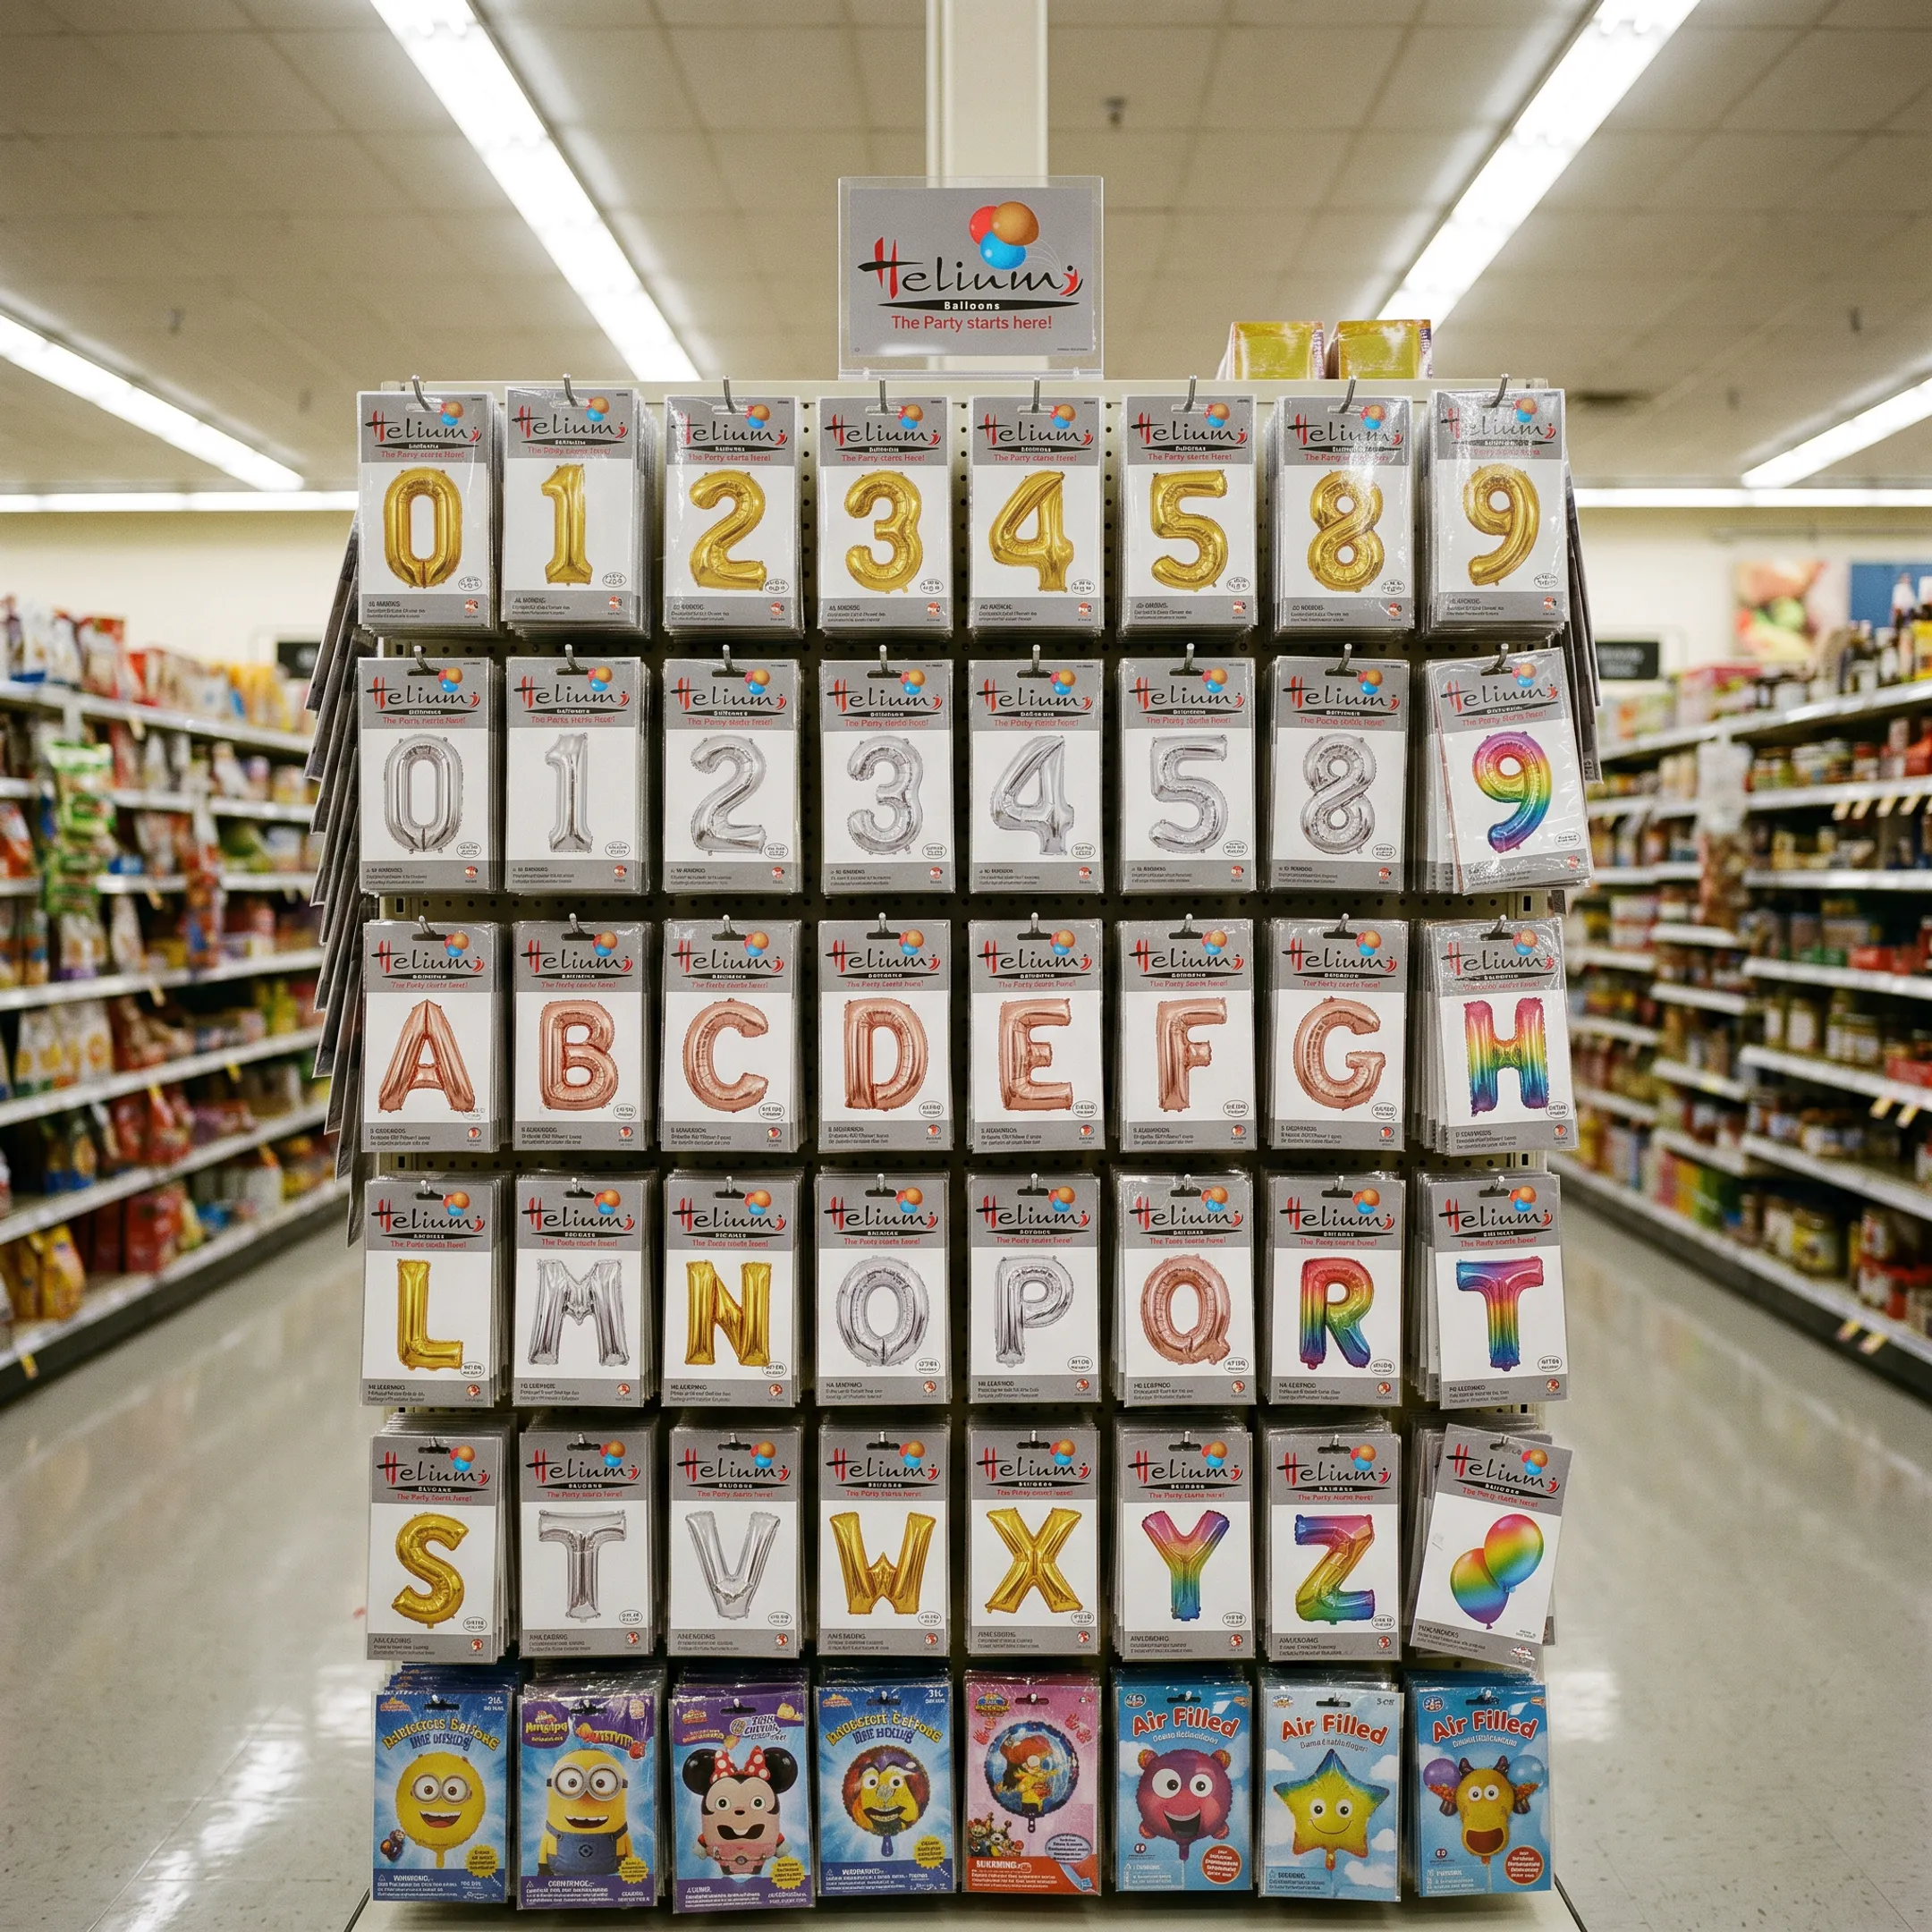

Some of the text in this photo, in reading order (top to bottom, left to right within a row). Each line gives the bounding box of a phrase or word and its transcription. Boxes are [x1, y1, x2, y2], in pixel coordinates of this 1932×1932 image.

[858, 236, 1080, 300] Helium
[944, 301, 1001, 310] Balloons
[891, 315, 1052, 333] The Party starts here!
[365, 411, 481, 443] Helium
[512, 405, 628, 437] Helium
[672, 410, 788, 445] Helium
[825, 414, 941, 445] Helium
[977, 414, 1094, 445] Helium
[1131, 411, 1248, 445] Helium
[1287, 414, 1402, 445] Helium
[384, 466, 462, 589] 0
[541, 463, 593, 585] 1
[689, 470, 766, 590] 2
[844, 470, 921, 593] 3
[989, 470, 1073, 592] 4
[1150, 470, 1228, 592] 5
[1308, 470, 1385, 593] 8
[1462, 463, 1539, 587] 9
[366, 676, 480, 709] Helium
[513, 675, 630, 708] Helium
[670, 677, 786, 710] Helium
[826, 679, 942, 712] Helium
[977, 679, 1092, 712] Helium
[1129, 677, 1245, 709] Helium
[1283, 676, 1400, 711] Helium
[1441, 675, 1558, 712] Helium
[384, 733, 463, 853] 0
[545, 733, 593, 852] 1
[691, 734, 767, 855] 2
[847, 735, 923, 855] 3
[990, 735, 1074, 855] 4
[1148, 735, 1228, 853] 5
[1301, 733, 1377, 855] 8
[1472, 731, 1552, 853] 9
[371, 940, 485, 973] Helium
[521, 939, 633, 972] Helium
[671, 940, 784, 973] Helium
[826, 940, 940, 972] Helium
[977, 940, 1092, 972] Helium
[1129, 939, 1243, 972] Helium
[1282, 937, 1397, 973] Helium
[1441, 942, 1555, 975] Helium
[378, 999, 475, 1113] A
[540, 1000, 619, 1110] B
[682, 998, 769, 1113] C
[843, 998, 928, 1111] D
[999, 998, 1073, 1111] E
[1156, 996, 1227, 1112] F
[1292, 996, 1385, 1111] G
[1463, 997, 1549, 1117] H
[371, 1199, 486, 1233] Helium
[521, 1198, 635, 1231] Helium
[673, 1198, 786, 1231] Helium
[824, 1196, 938, 1230] Helium
[976, 1196, 1090, 1228] Helium
[1130, 1196, 1243, 1230] Helium
[1280, 1197, 1395, 1230] Helium
[1438, 1199, 1553, 1233] Helium
[397, 1259, 463, 1371] L
[528, 1259, 630, 1365] M
[685, 1260, 772, 1365] N
[836, 1255, 929, 1366] O
[995, 1255, 1073, 1368] P
[1140, 1254, 1231, 1365] Q
[1300, 1257, 1374, 1369] R
[1456, 1256, 1544, 1371] T
[377, 1450, 490, 1486] Helium
[526, 1448, 640, 1483] Helium
[677, 1448, 791, 1483] Helium
[826, 1448, 940, 1482] Helium
[977, 1447, 1090, 1481] Helium
[1128, 1450, 1242, 1483] Helium
[1276, 1453, 1391, 1485] Helium
[1446, 1443, 1560, 1495] Helium
[391, 1512, 469, 1629] S
[538, 1509, 626, 1622] T
[685, 1511, 780, 1620] V
[829, 1512, 936, 1614] W
[986, 1508, 1082, 1614] X
[1141, 1510, 1230, 1621] Y
[1294, 1514, 1375, 1624] Z
[1133, 1706, 1241, 1738] Air Filled
[1281, 1716, 1317, 1742] Air
[1321, 1712, 1390, 1747] Filled
[1433, 1715, 1468, 1743] Air
[1472, 1708, 1539, 1740] Filled
